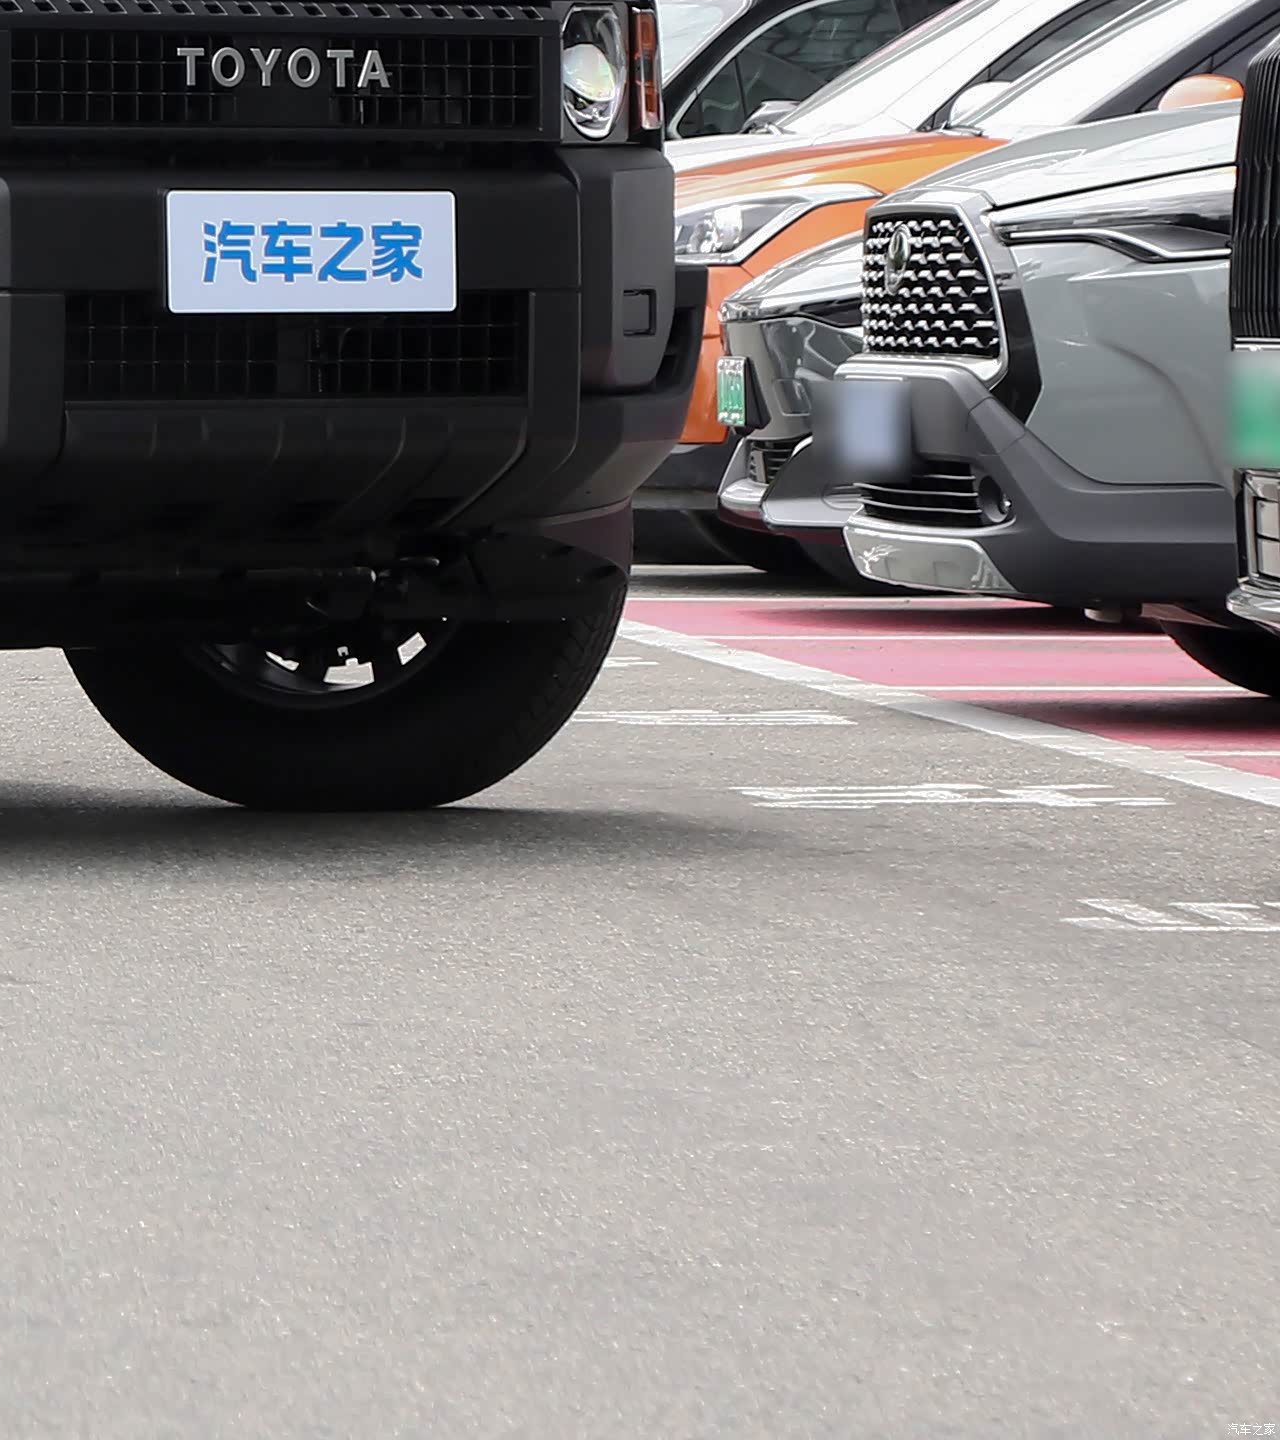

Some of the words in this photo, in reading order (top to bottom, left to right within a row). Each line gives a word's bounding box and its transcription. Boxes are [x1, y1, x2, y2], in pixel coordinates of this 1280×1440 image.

[177, 46, 390, 88] TOYOTA
[202, 219, 424, 284] 汽车之家
